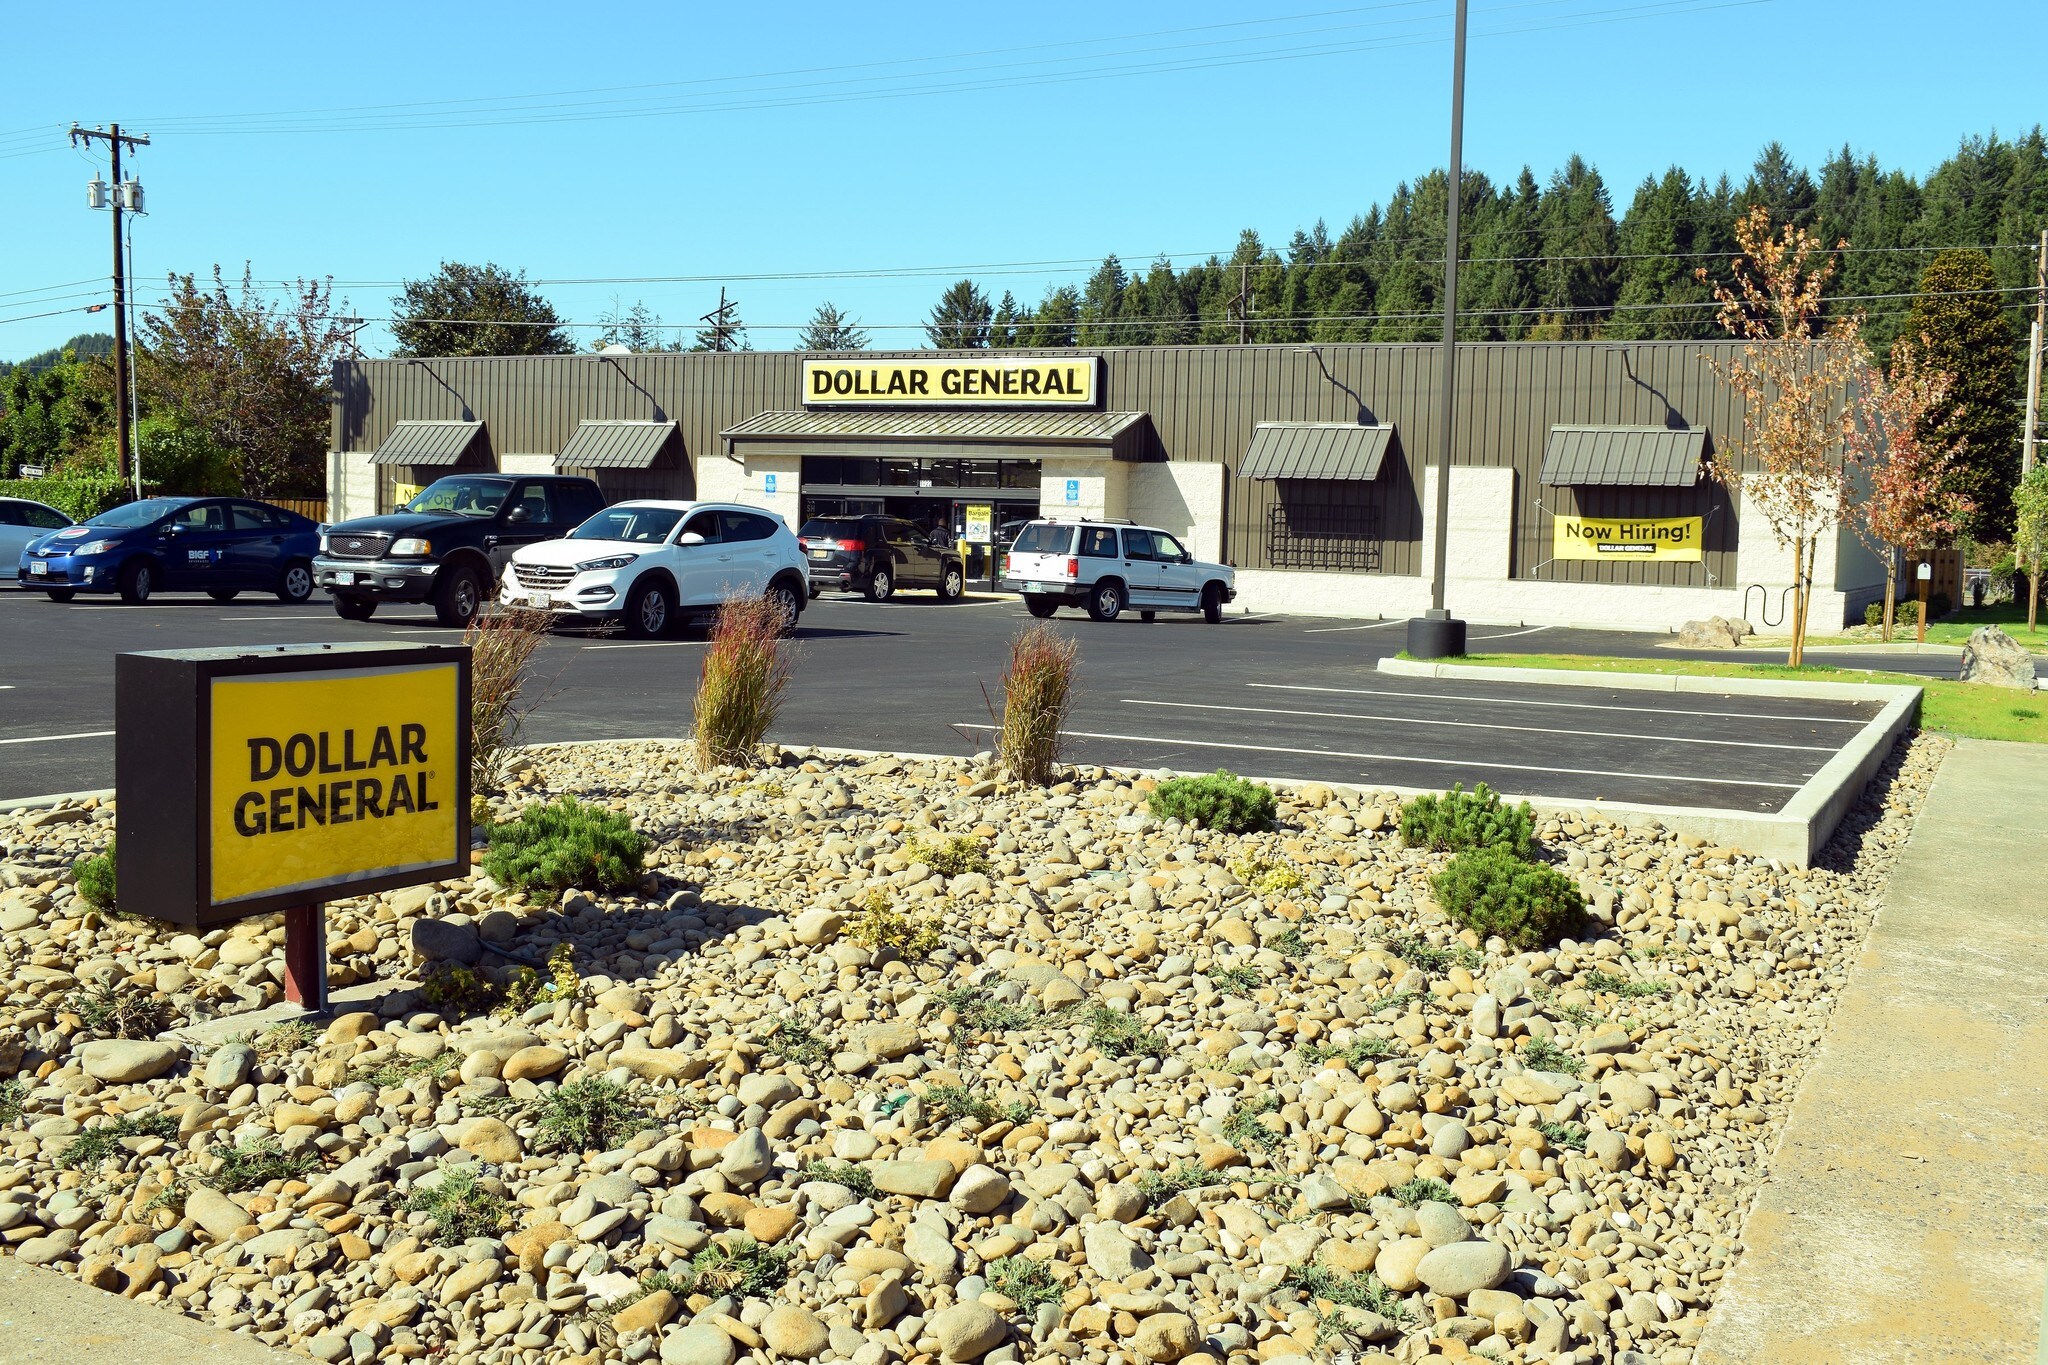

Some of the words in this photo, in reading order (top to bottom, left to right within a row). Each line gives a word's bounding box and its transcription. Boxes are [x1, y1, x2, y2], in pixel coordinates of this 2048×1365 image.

[812, 369, 929, 395] DOLLAR
[941, 367, 1084, 395] GENERAL
[434, 494, 457, 508] Ope
[1566, 523, 1612, 539] Now
[1620, 523, 1690, 542] Hiring!
[1625, 544, 1655, 552] GENERAL
[247, 722, 429, 783] DOLLAR
[233, 771, 439, 838] GENERAL
